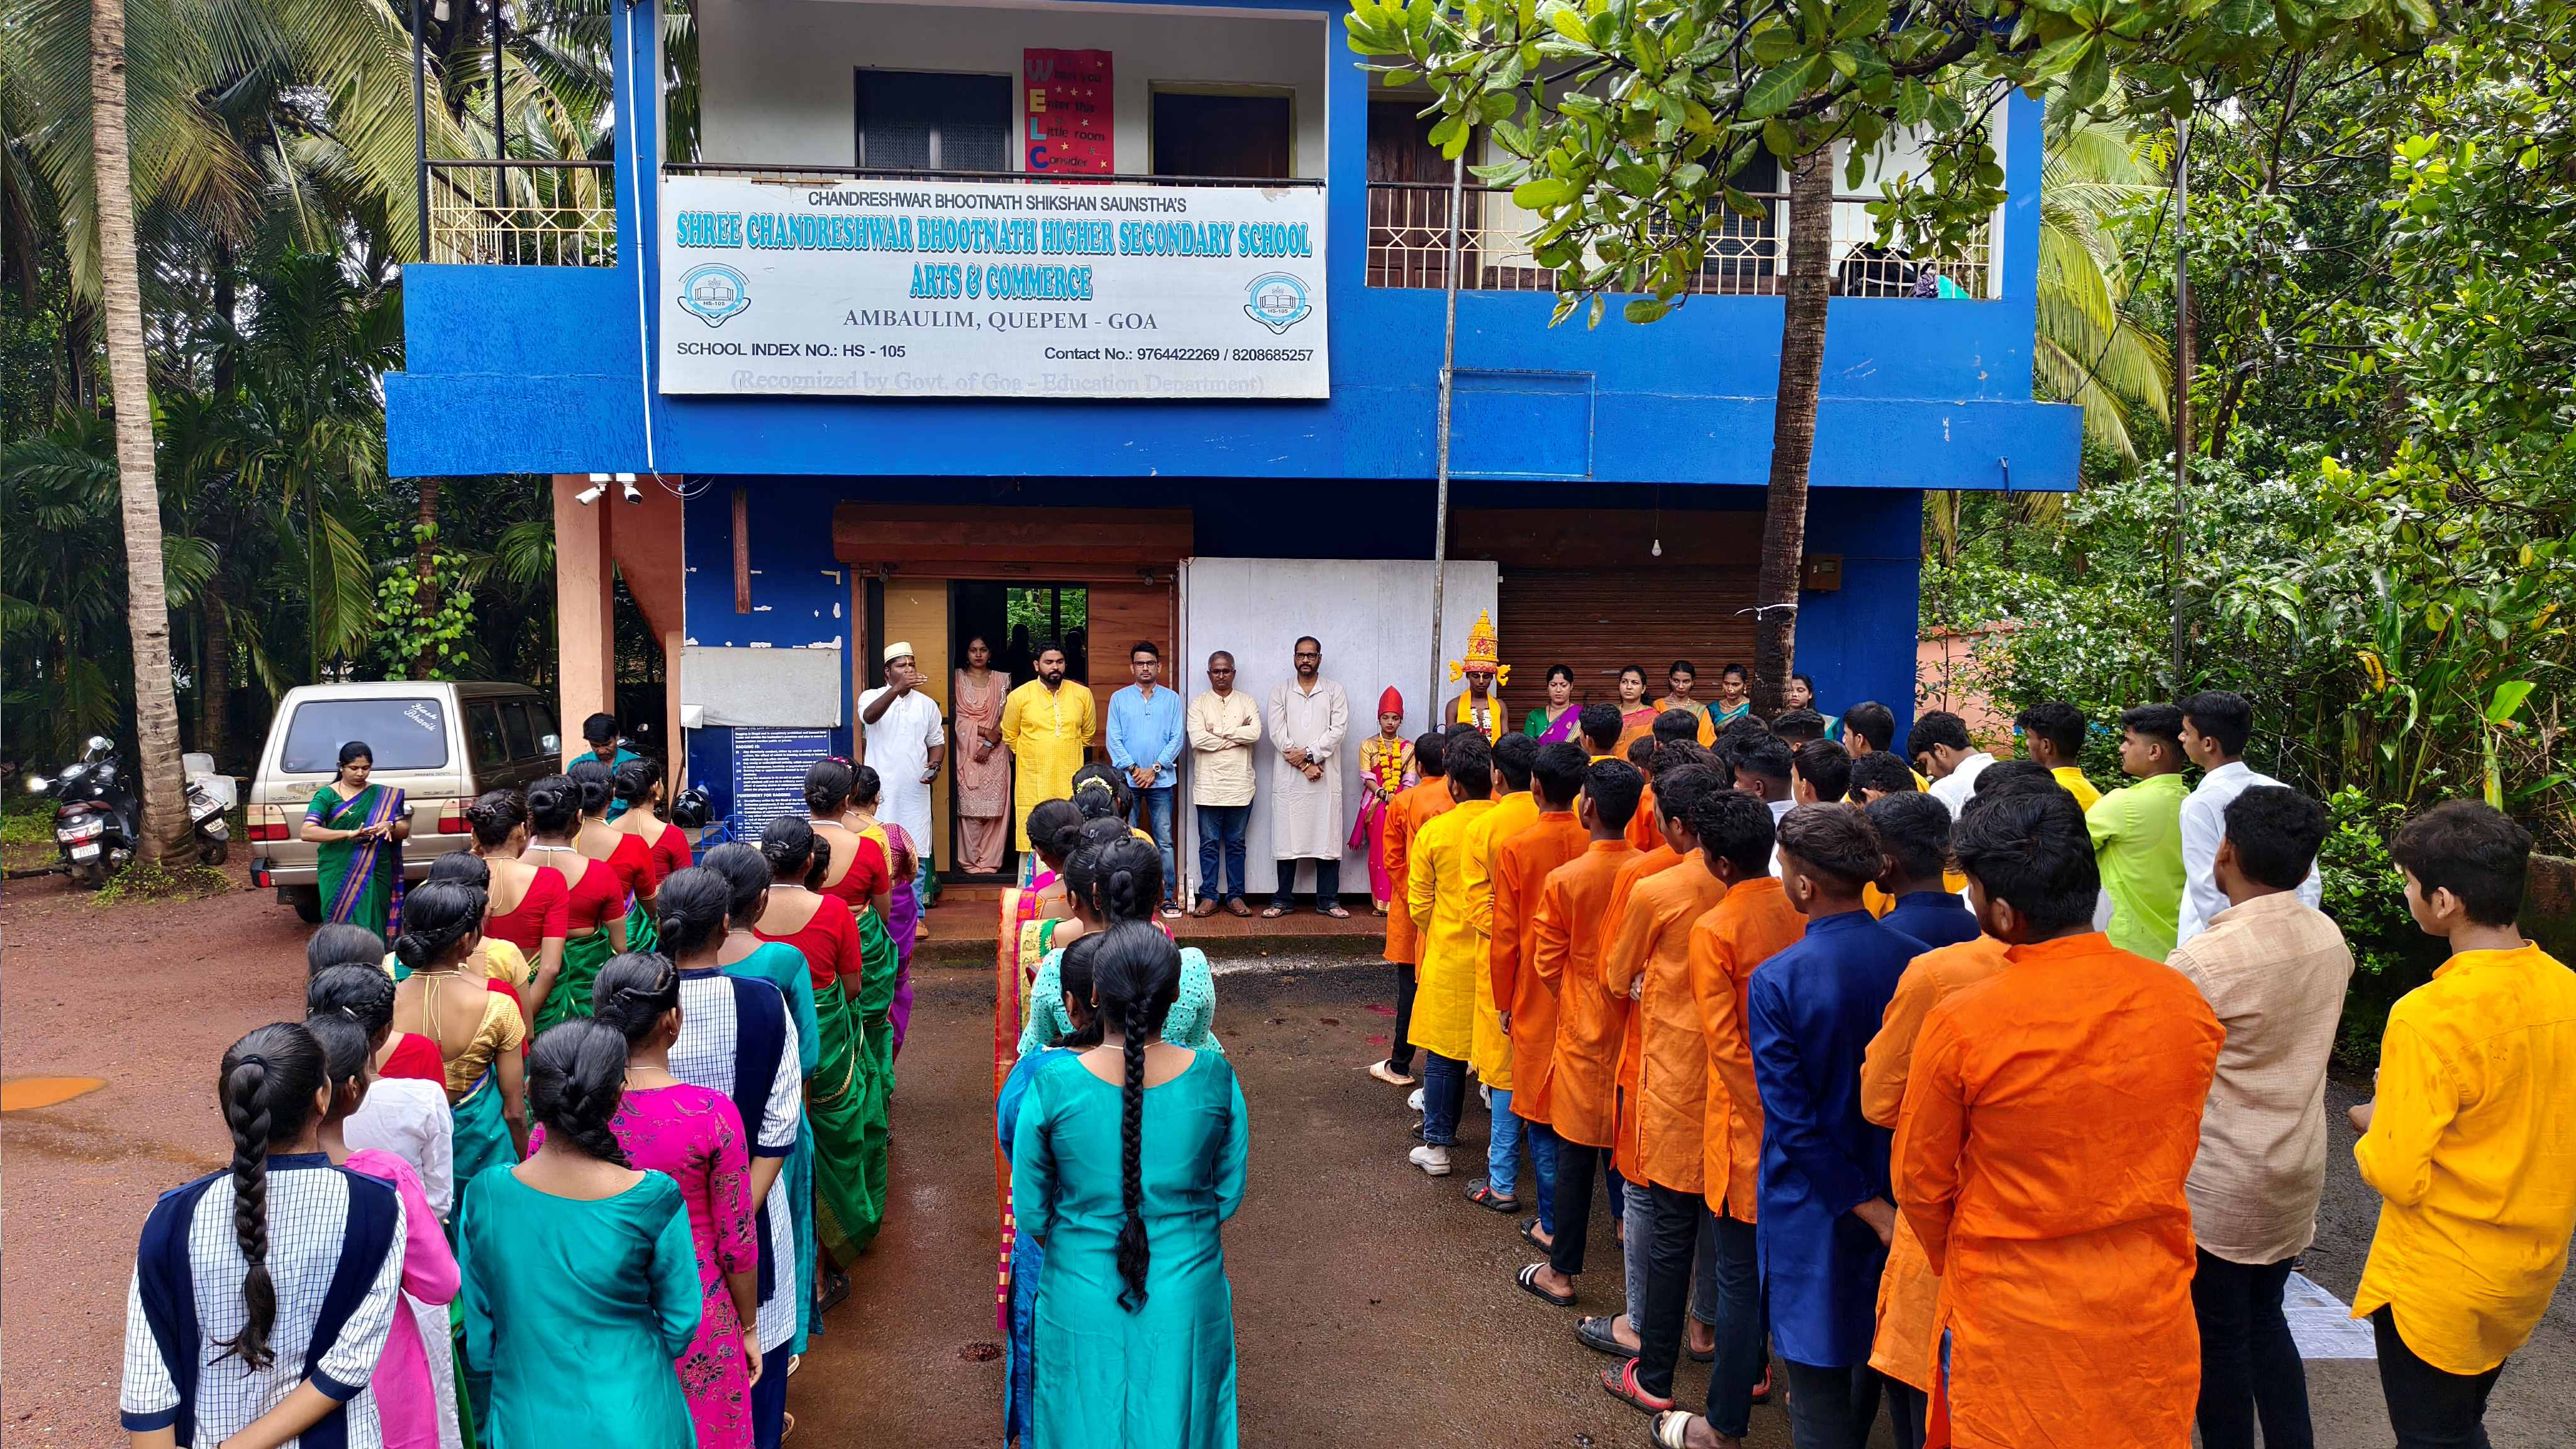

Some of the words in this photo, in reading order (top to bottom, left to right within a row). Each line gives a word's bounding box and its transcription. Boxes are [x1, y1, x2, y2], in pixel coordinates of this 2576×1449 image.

[1030, 117, 1068, 140] Little
[1074, 130, 1105, 142] room
[1030, 146, 1087, 169] Consider
[808, 191, 932, 208] CHANDRESHWAR
[935, 194, 1023, 210] BHOOTNATH
[1026, 196, 1097, 211] SHIKSHAN
[1100, 197, 1187, 213] SAUNSTHA'S
[676, 210, 743, 250] SHREE
[746, 213, 914, 253] CHANDRESHWAR
[916, 216, 1039, 255] BHOOTNATH
[1041, 218, 1115, 255] HIGHER
[1119, 219, 1234, 257] SECONDARY
[1238, 221, 1313, 257] SCHOOL
[909, 261, 962, 299] ARTS
[965, 262, 982, 299] &
[985, 264, 1093, 301] COMMERCE
[843, 309, 982, 331] AMBAULIM,
[988, 311, 1087, 333] QUEPEM
[1108, 313, 1158, 330] GOA
[677, 342, 747, 357] SCHOOL
[752, 343, 801, 357] INDEX
[805, 344, 838, 357] NO.:
[843, 345, 866, 357] HS
[880, 345, 906, 358] 105
[1044, 347, 1101, 361] Contact
[1104, 348, 1133, 360] No.:
[1136, 348, 1221, 361] 9764422269
[1223, 348, 1230, 362] /
[1231, 349, 1314, 362] 8208685257
[731, 369, 860, 394] (Recognized
[863, 372, 891, 395] by
[894, 372, 951, 392] Govt.
[955, 372, 978, 392] of
[981, 374, 1023, 392] Goa
[1041, 374, 1141, 392] Education
[1144, 374, 1265, 395] Department)
